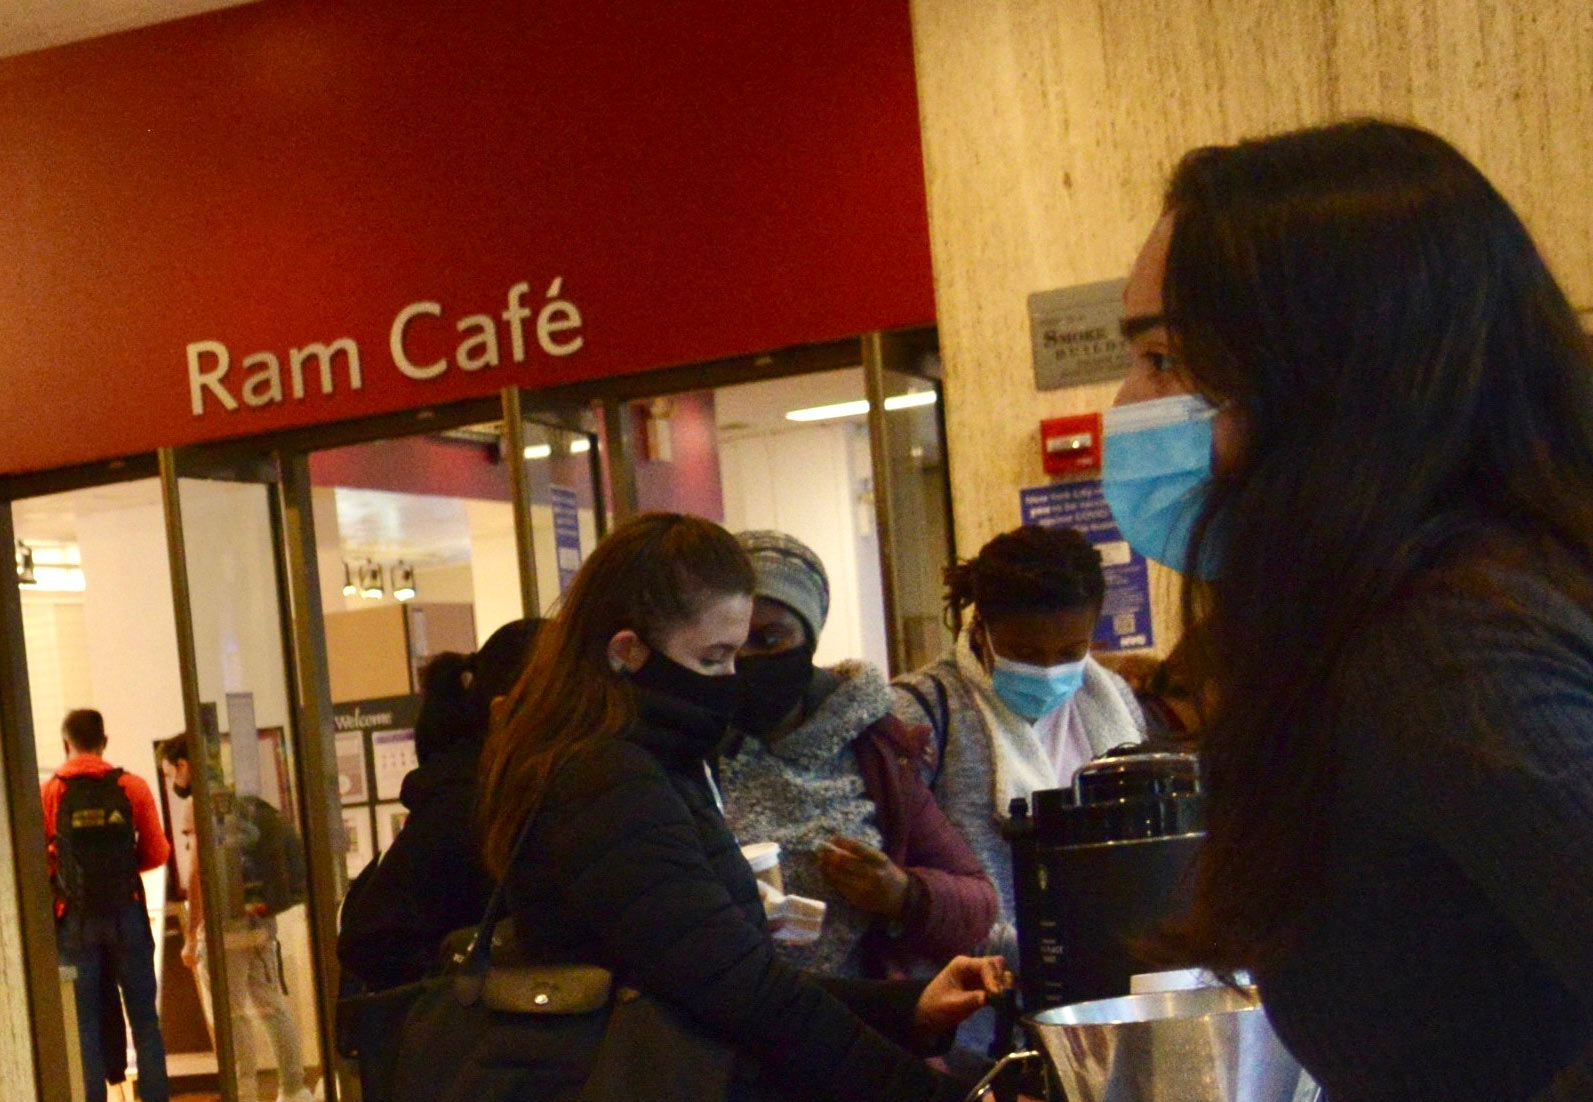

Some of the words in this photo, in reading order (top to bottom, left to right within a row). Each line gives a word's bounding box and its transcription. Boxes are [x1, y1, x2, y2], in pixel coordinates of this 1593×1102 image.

[185, 337, 363, 417] Ram
[389, 276, 586, 381] Café
[333, 707, 393, 731] Welcome
